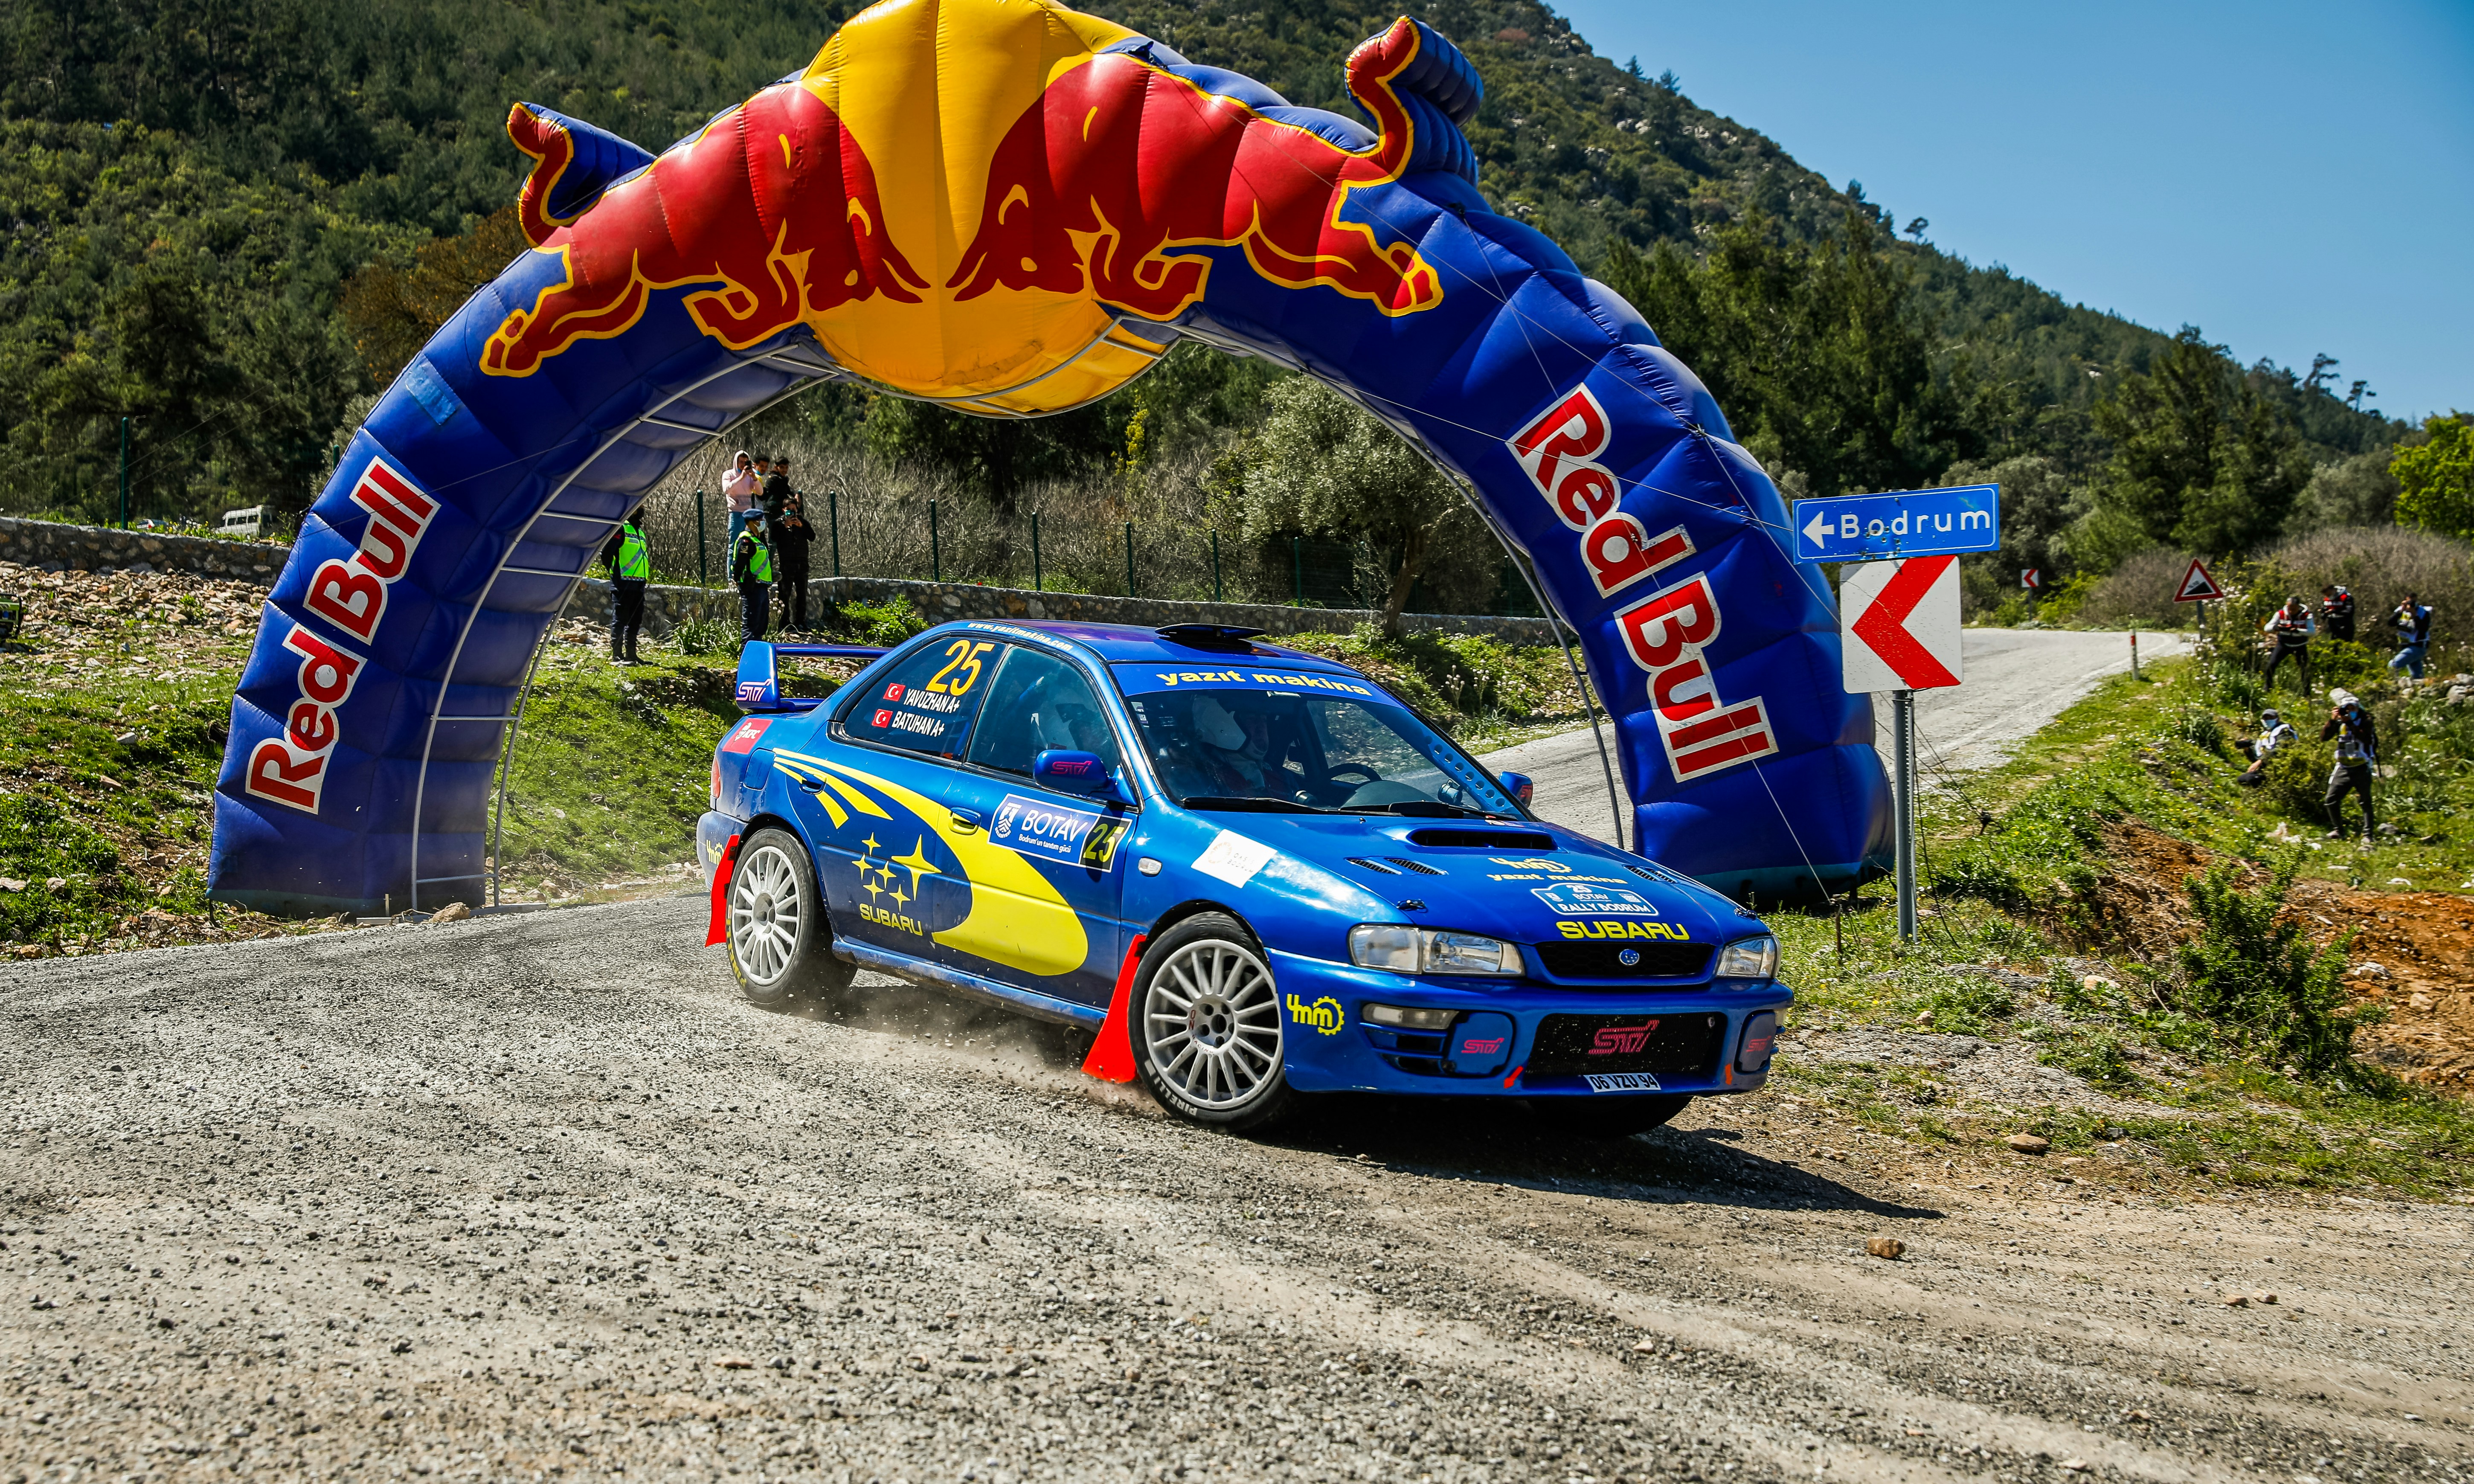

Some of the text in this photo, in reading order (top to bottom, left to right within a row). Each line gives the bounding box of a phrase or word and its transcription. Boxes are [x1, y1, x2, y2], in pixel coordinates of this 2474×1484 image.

[1840, 510, 1991, 539] Bodrum
[1506, 383, 1778, 781] Red Bull
[247, 456, 440, 813] Red Bull
[967, 622, 1074, 651] www.yazitmakina.com
[926, 639, 995, 696] 25
[1252, 673, 1373, 697] makina
[903, 688, 961, 714] YAVUZHAN A+
[741, 729, 761, 739] KFC
[891, 711, 945, 737] BATUHAN A+
[1021, 809, 1125, 863] BOTAV 25
[1059, 845, 1071, 853] gücü
[1547, 875, 1628, 884] makina
[1566, 885, 1592, 893] 25
[859, 903, 923, 936] SUBARU
[1557, 903, 1652, 912] RALLY BODRUM
[1556, 921, 1690, 940] SUBARU
[1589, 1074, 1659, 1090] 06 VZU 94
[1153, 1076, 1198, 1116] PIRELLI
